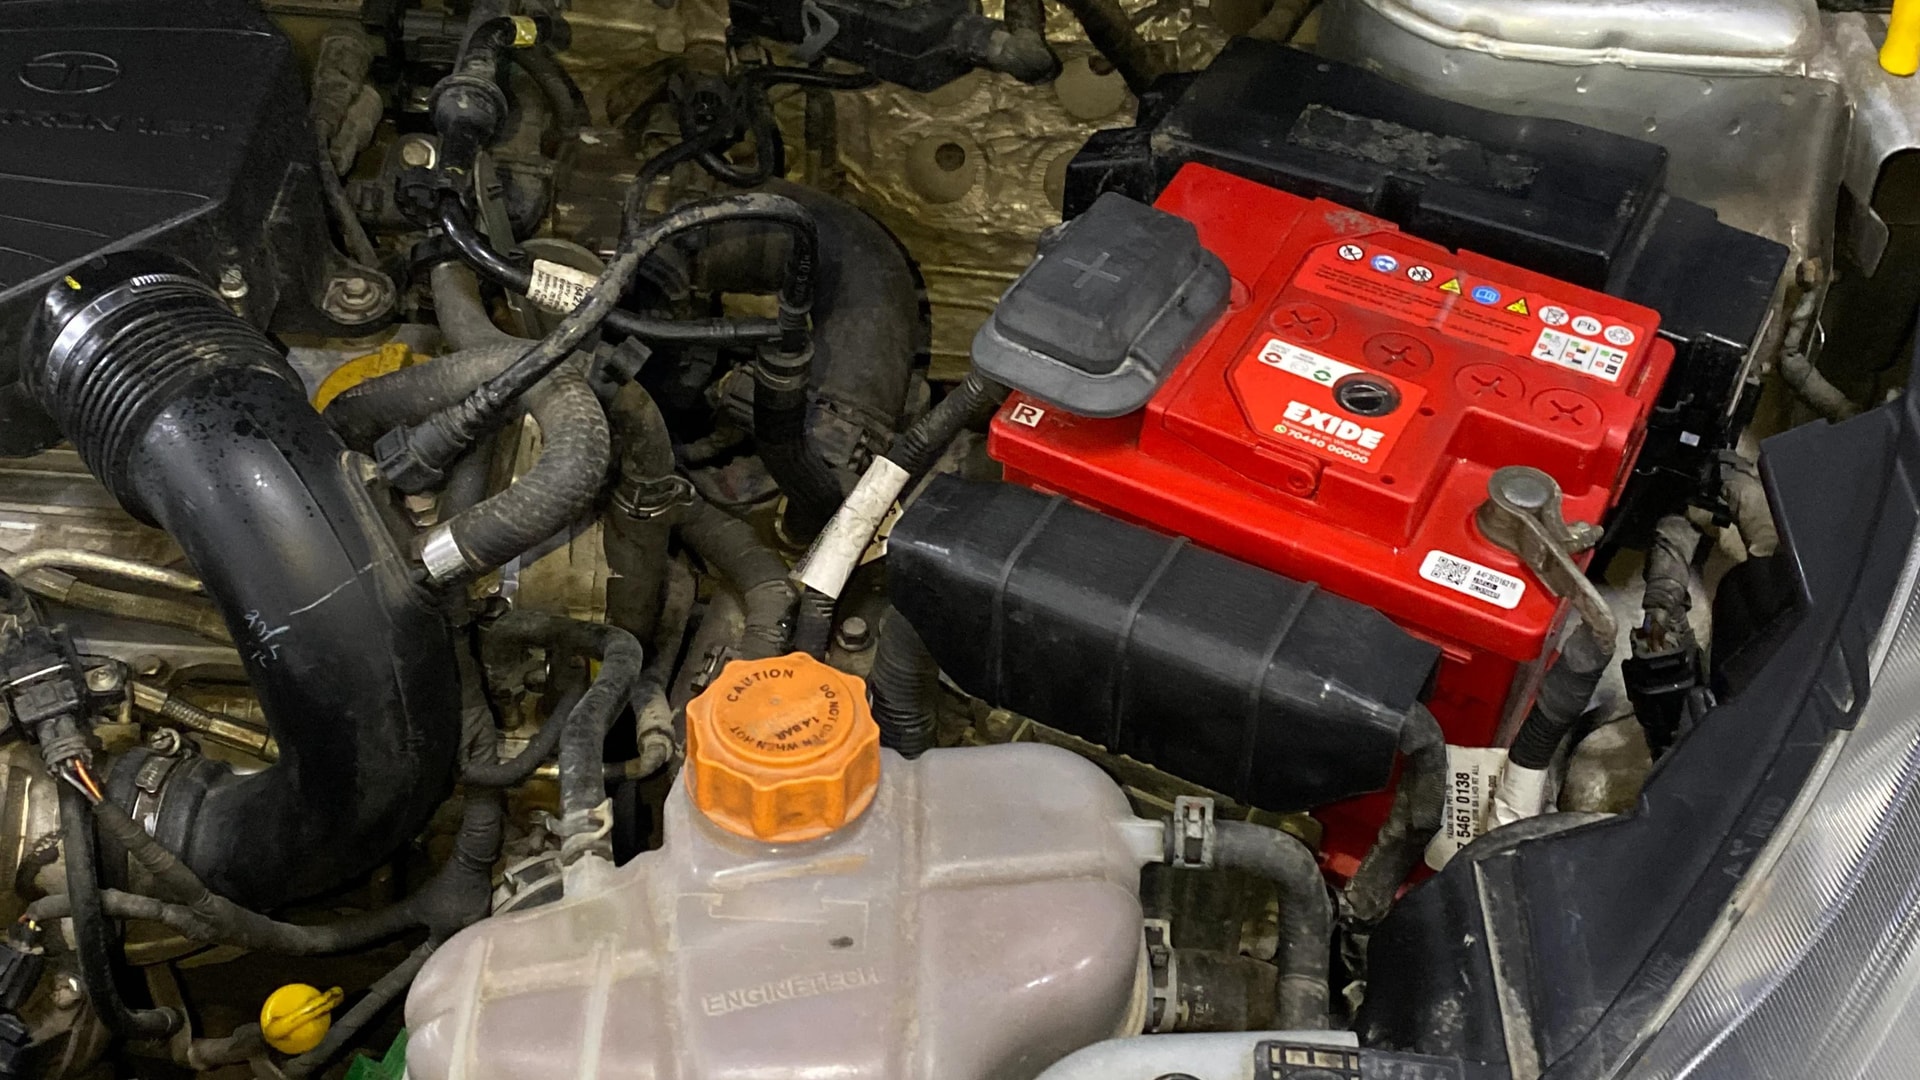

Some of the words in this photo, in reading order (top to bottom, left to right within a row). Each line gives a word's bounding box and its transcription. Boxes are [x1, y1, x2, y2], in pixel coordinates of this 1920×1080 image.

[1576, 320, 1597, 332] Pb
[1014, 406, 1037, 424] R
[1282, 400, 1385, 450] EXIDE
[1288, 429, 1326, 448] 70440
[1327, 440, 1369, 464] 00000
[727, 669, 794, 702] CAUTION
[820, 683, 836, 700] DO
[829, 701, 840, 723] NOT
[730, 726, 756, 744] HOT
[756, 740, 799, 752] WHEN
[1455, 772, 1471, 804] 0138
[1456, 809, 1471, 838] 5461
[701, 967, 881, 1017] ENGINETECH
